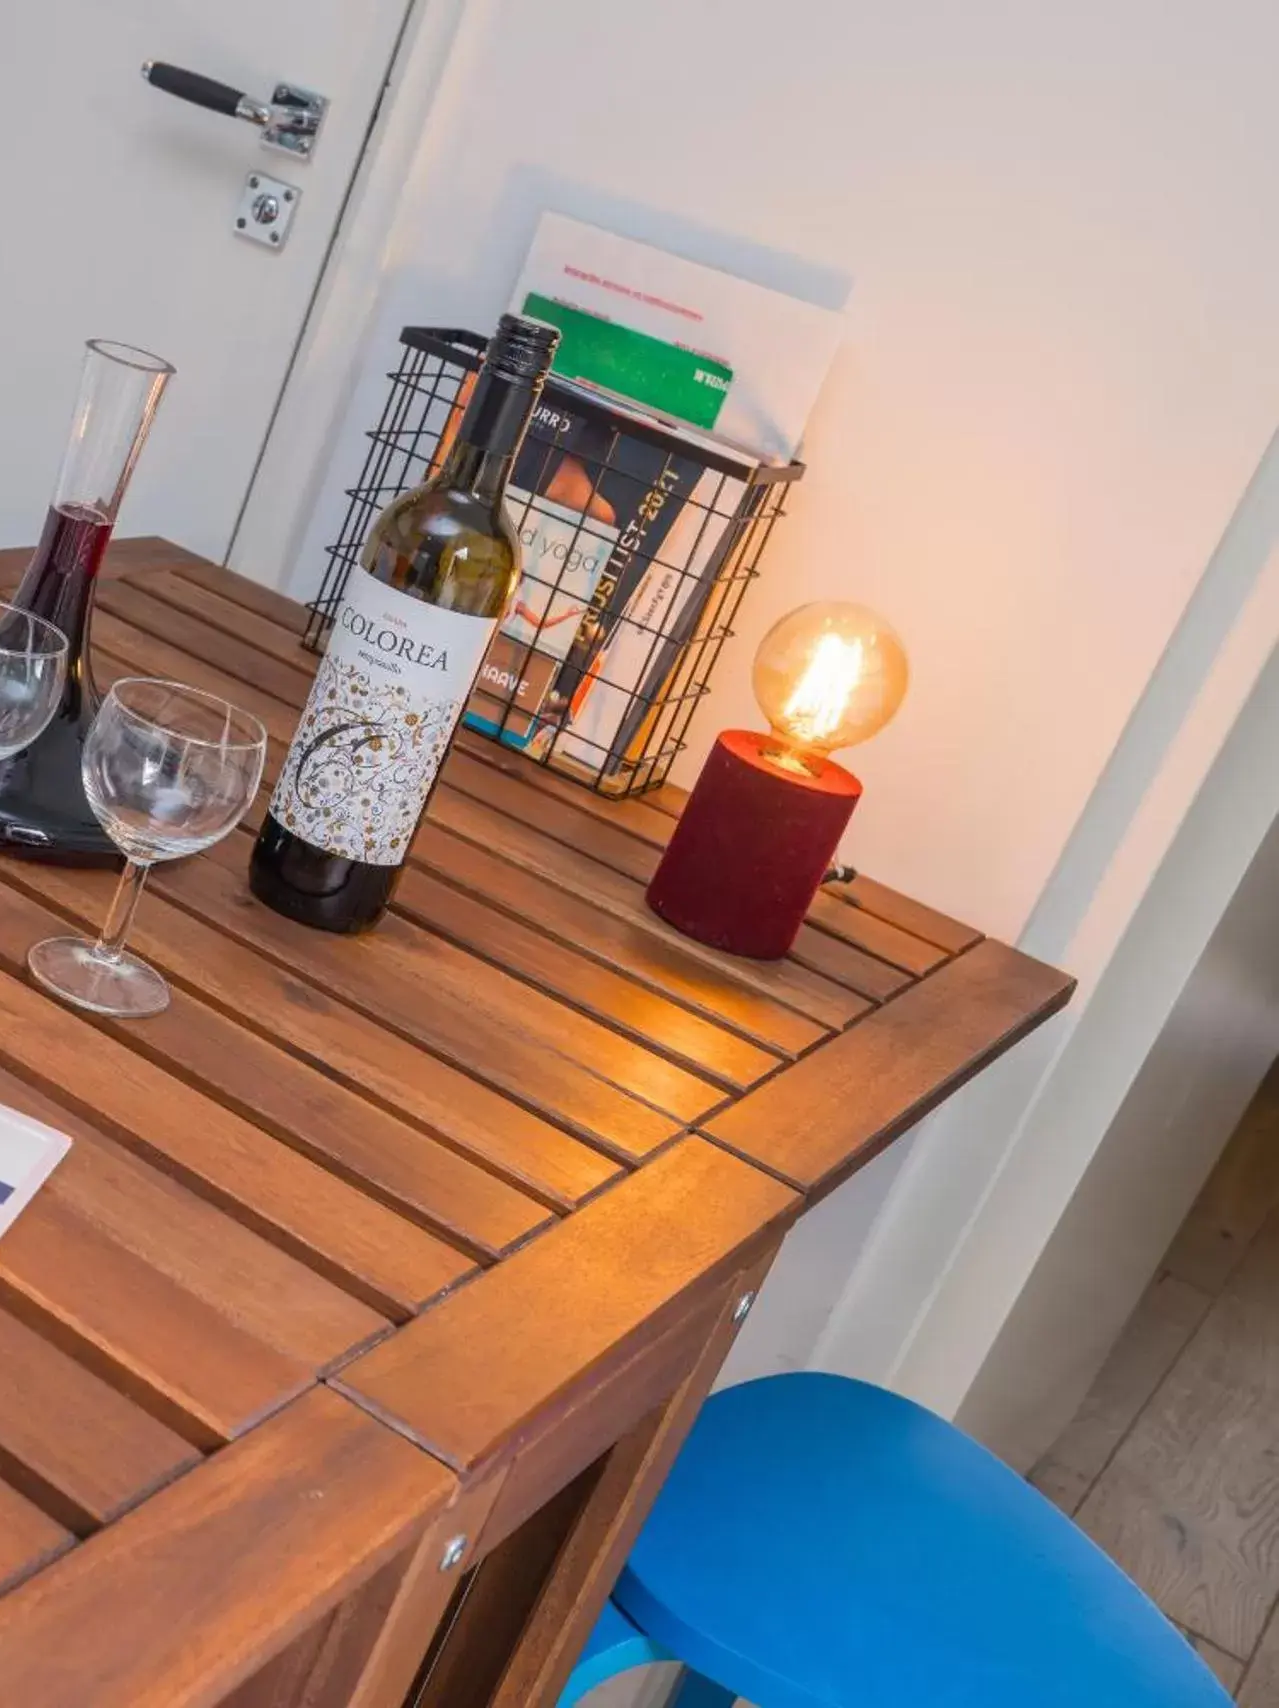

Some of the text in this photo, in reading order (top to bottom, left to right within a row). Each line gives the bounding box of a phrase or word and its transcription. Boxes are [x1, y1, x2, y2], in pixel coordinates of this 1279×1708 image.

[530, 405, 571, 433] URRO
[539, 536, 600, 573] yoga
[341, 605, 450, 672] COLOREA
